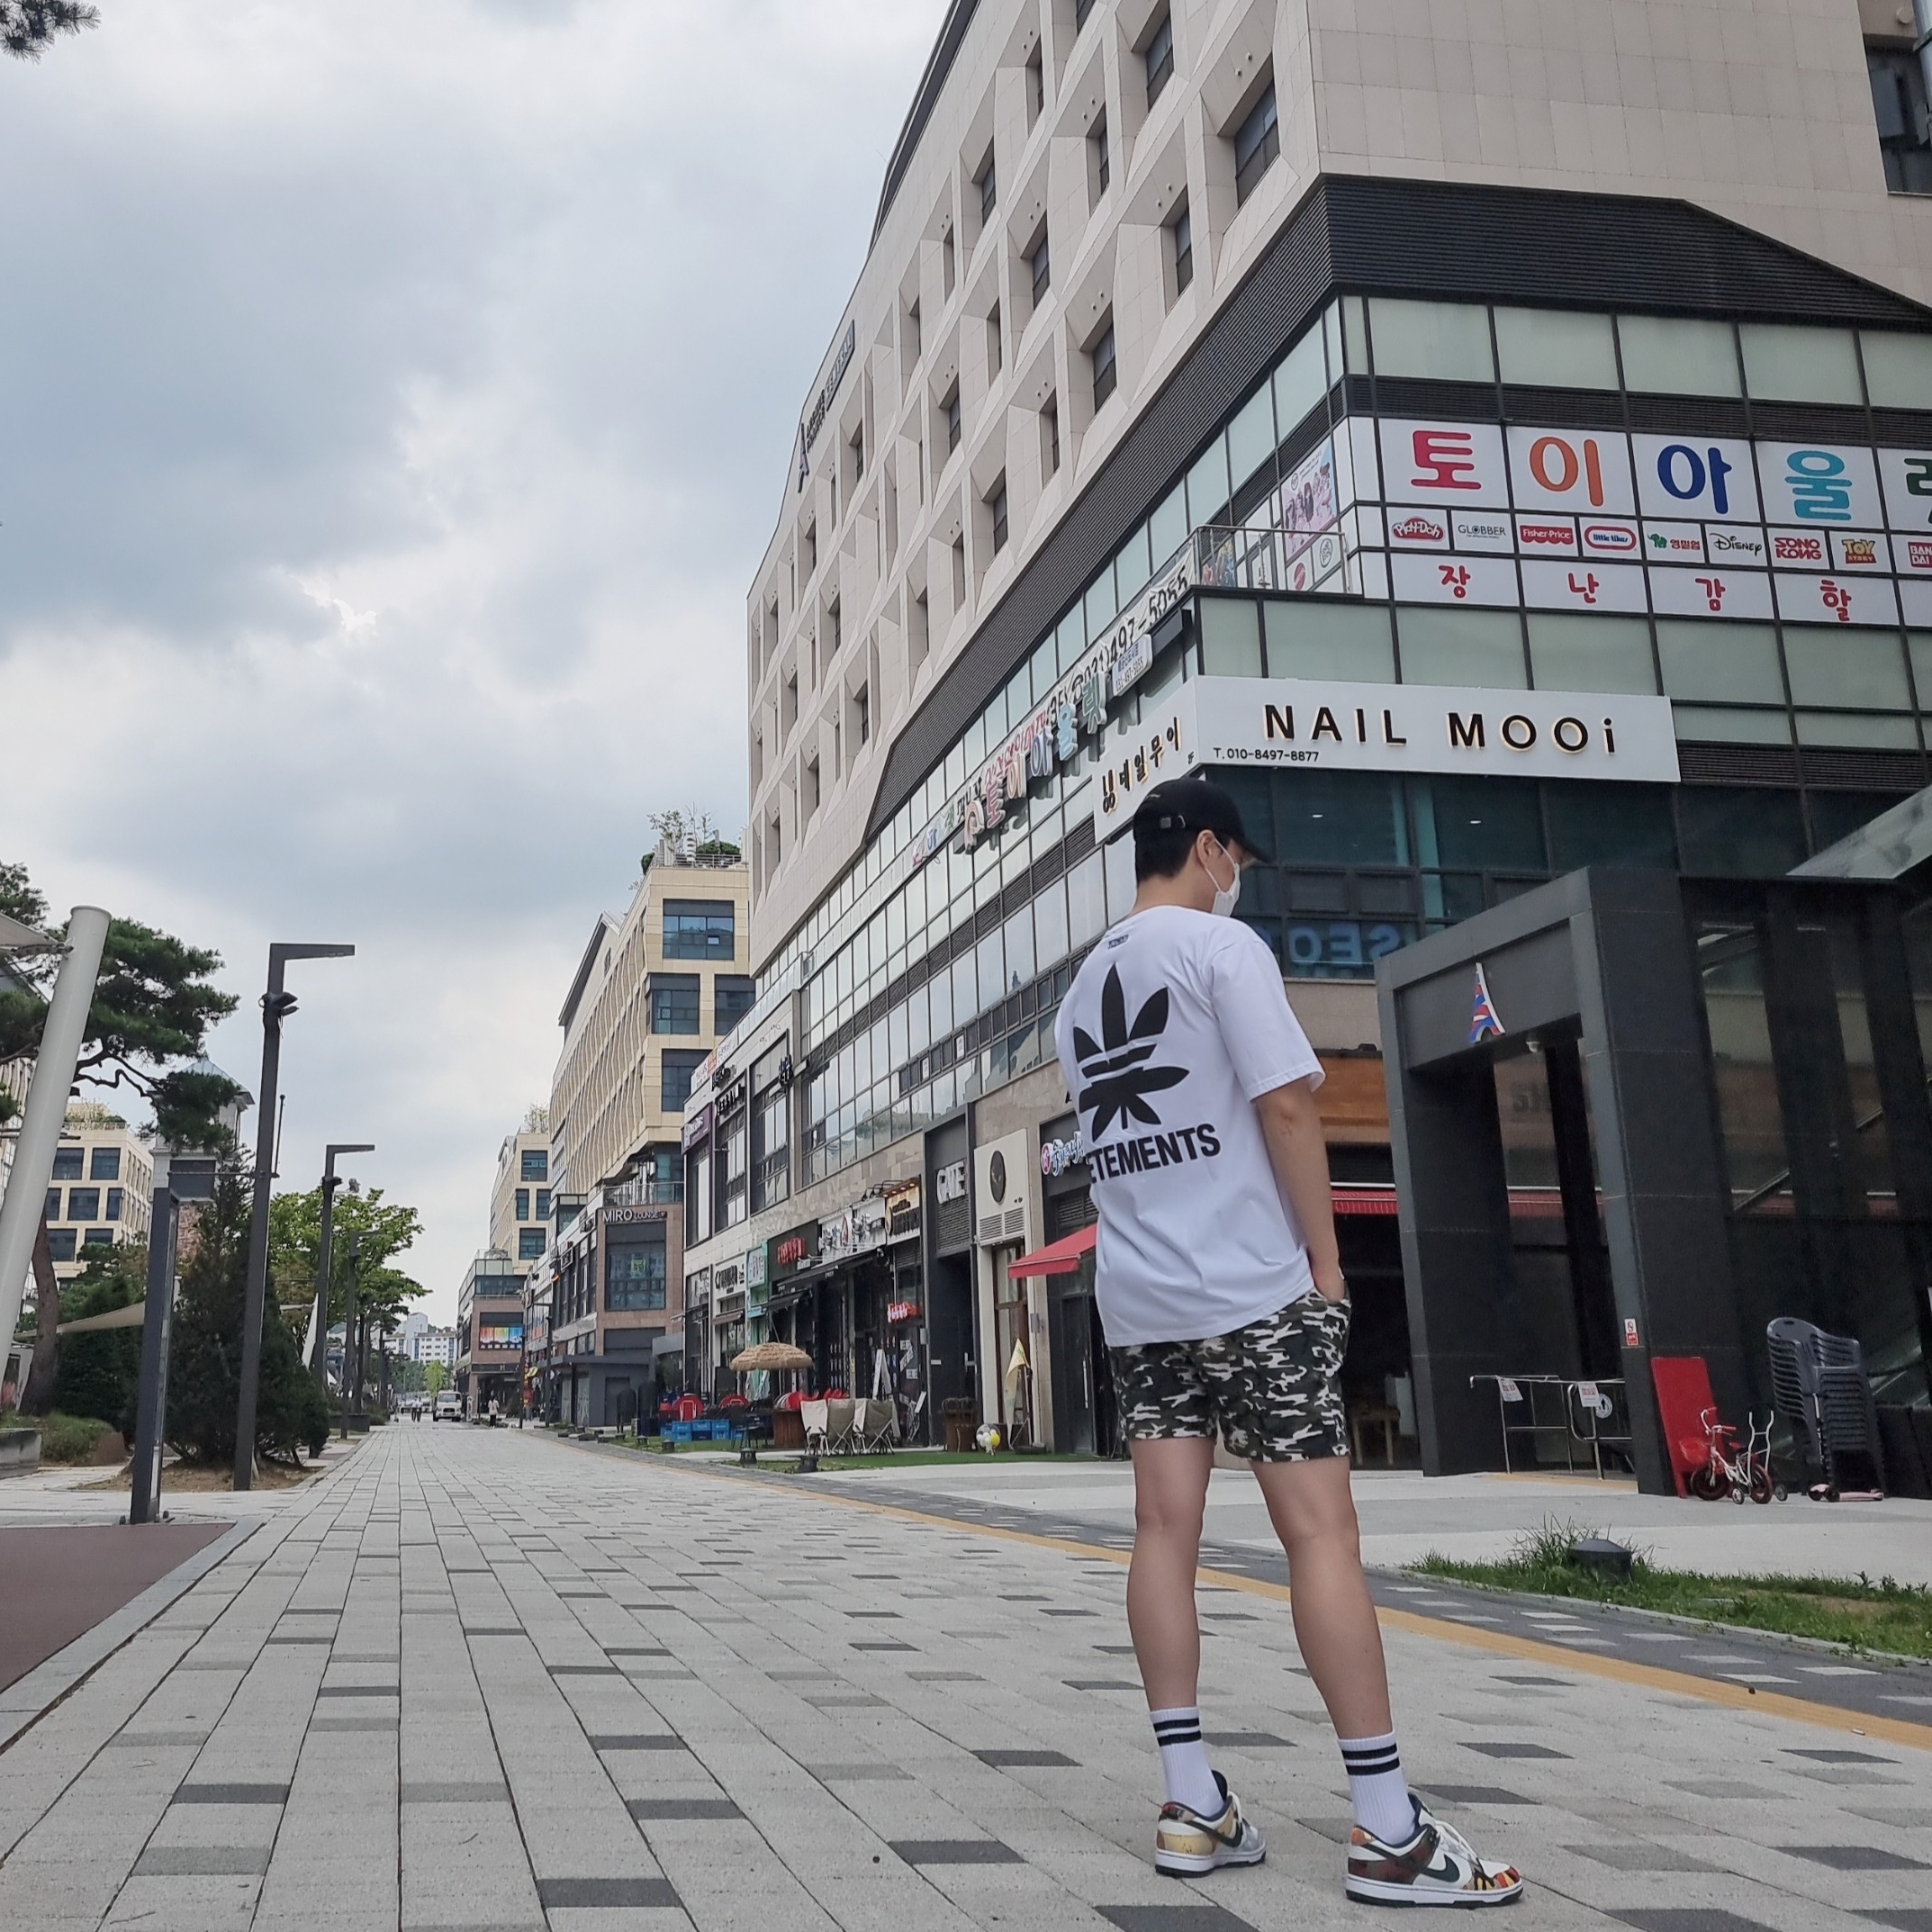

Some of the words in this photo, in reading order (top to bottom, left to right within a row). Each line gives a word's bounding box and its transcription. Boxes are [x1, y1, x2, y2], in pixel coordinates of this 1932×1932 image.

[1458, 524, 1506, 536] GLOBBER
[1522, 528, 1572, 539] Fisher-Price
[1264, 704, 1407, 745] NAIL
[602, 1208, 633, 1223] MIRO
